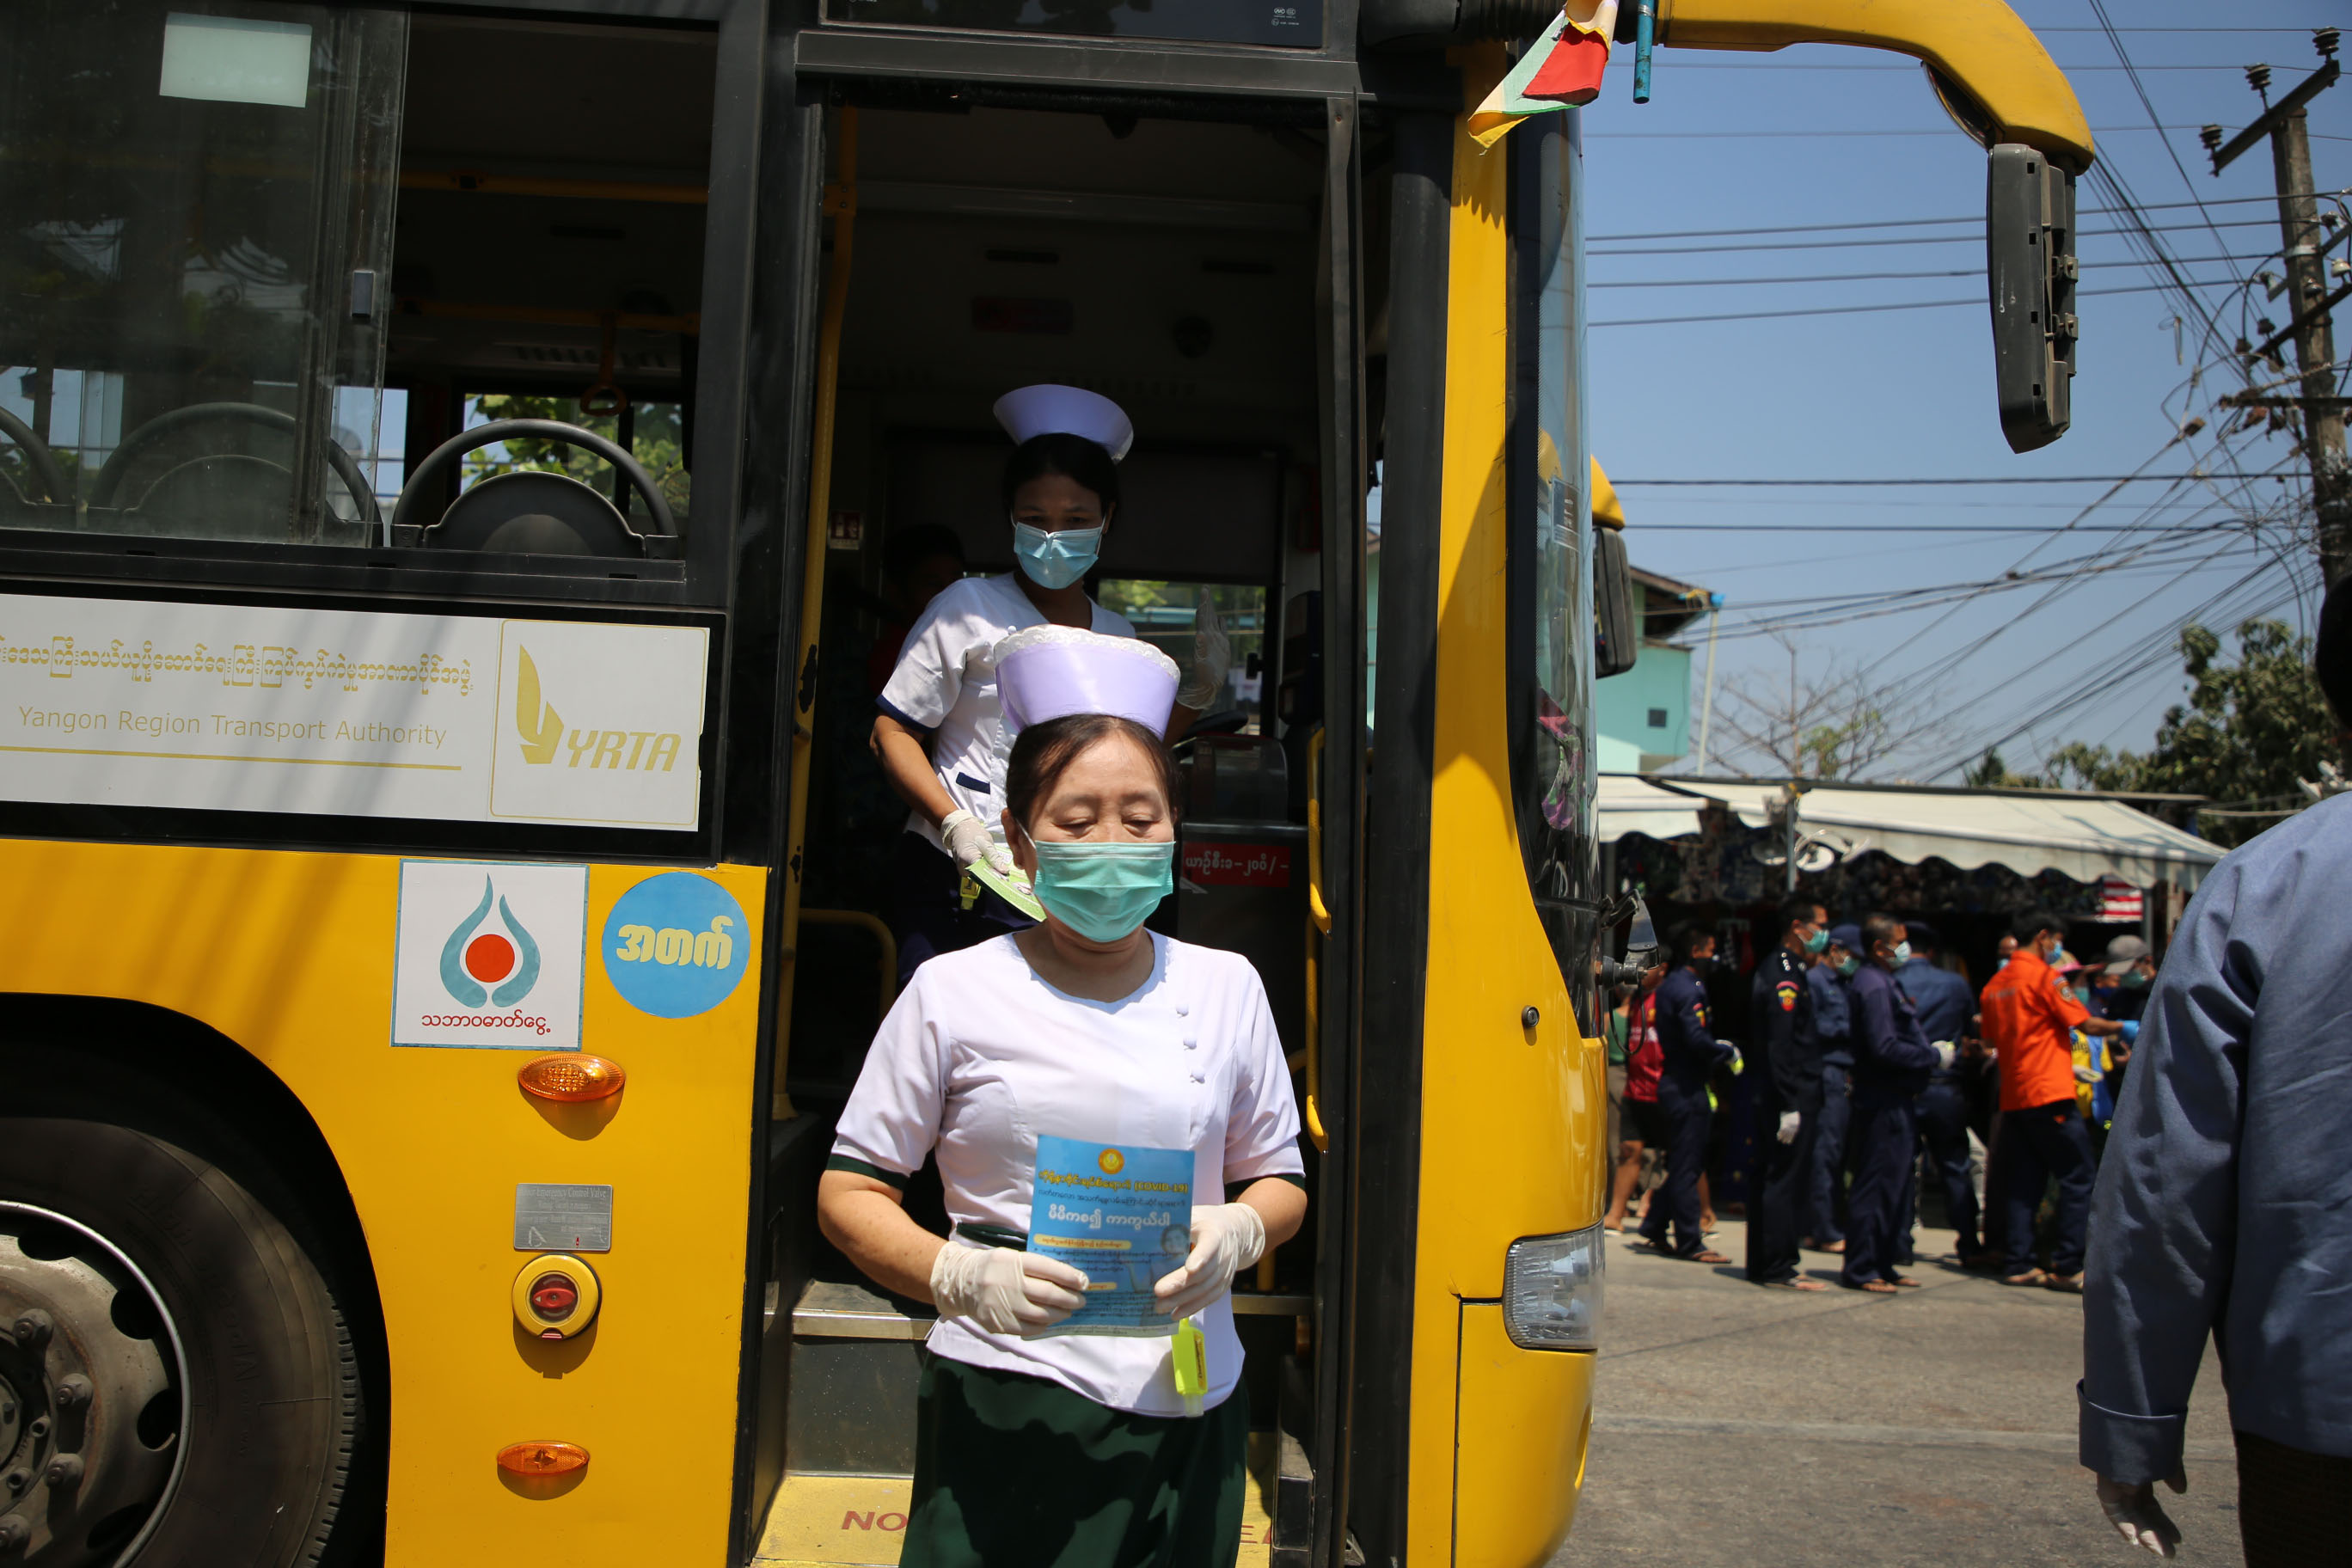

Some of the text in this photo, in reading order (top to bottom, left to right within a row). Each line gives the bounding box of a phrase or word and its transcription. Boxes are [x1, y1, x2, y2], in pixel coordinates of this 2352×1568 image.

[19, 706, 447, 750] Yangon Region Transport Authority
[567, 729, 682, 772] YRTA
[616, 915, 734, 970] အတက်
[421, 1009, 552, 1036] သဘာဝဓာတ်ငွေ့
[567, 1187, 590, 1197] Control
[1134, 1181, 1189, 1194] (COVID-19)
[841, 1510, 908, 1532] NO
